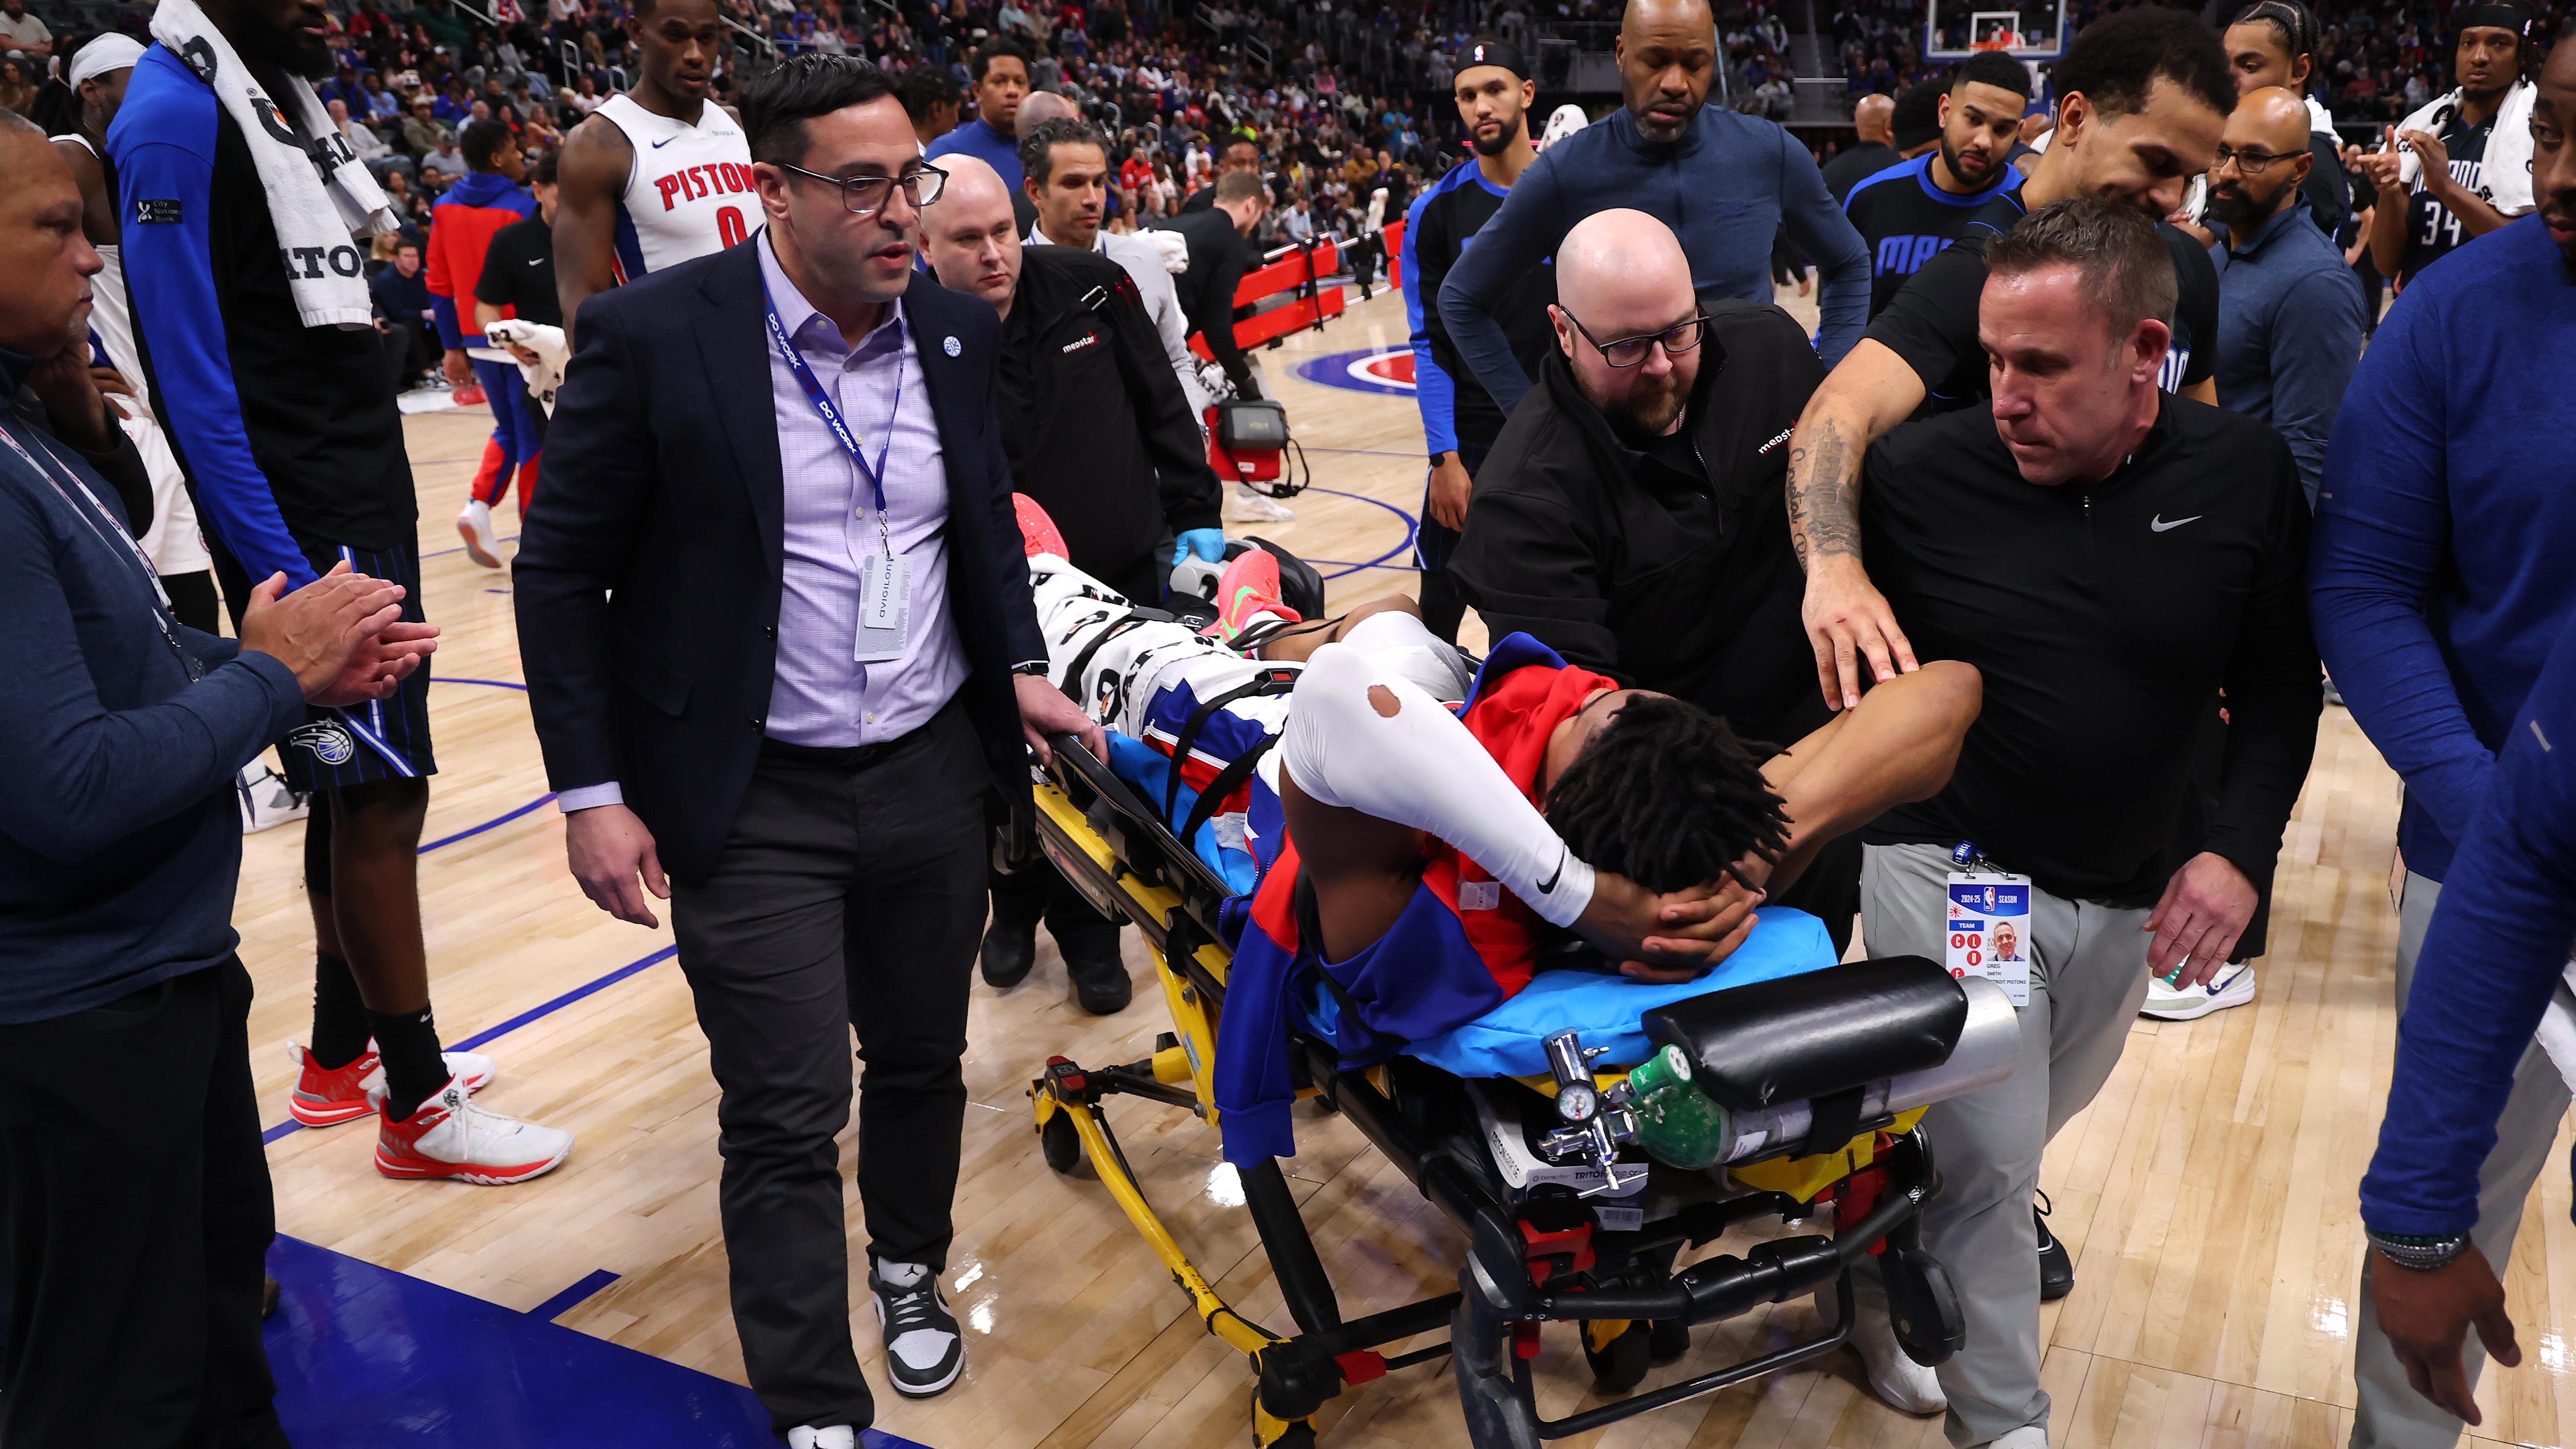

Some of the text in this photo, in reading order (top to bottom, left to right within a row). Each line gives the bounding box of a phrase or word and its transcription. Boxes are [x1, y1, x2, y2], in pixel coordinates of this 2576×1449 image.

[654, 162, 755, 211] PISTON
[2421, 201, 2461, 246] 34
[768, 312, 801, 369] DO WORK
[819, 401, 857, 454] DO WORK
[1961, 894, 2018, 904] 2024-25 SEASON
[1955, 936, 1962, 947] C
[1972, 936, 1977, 947] L
[1972, 952, 1977, 964] B
